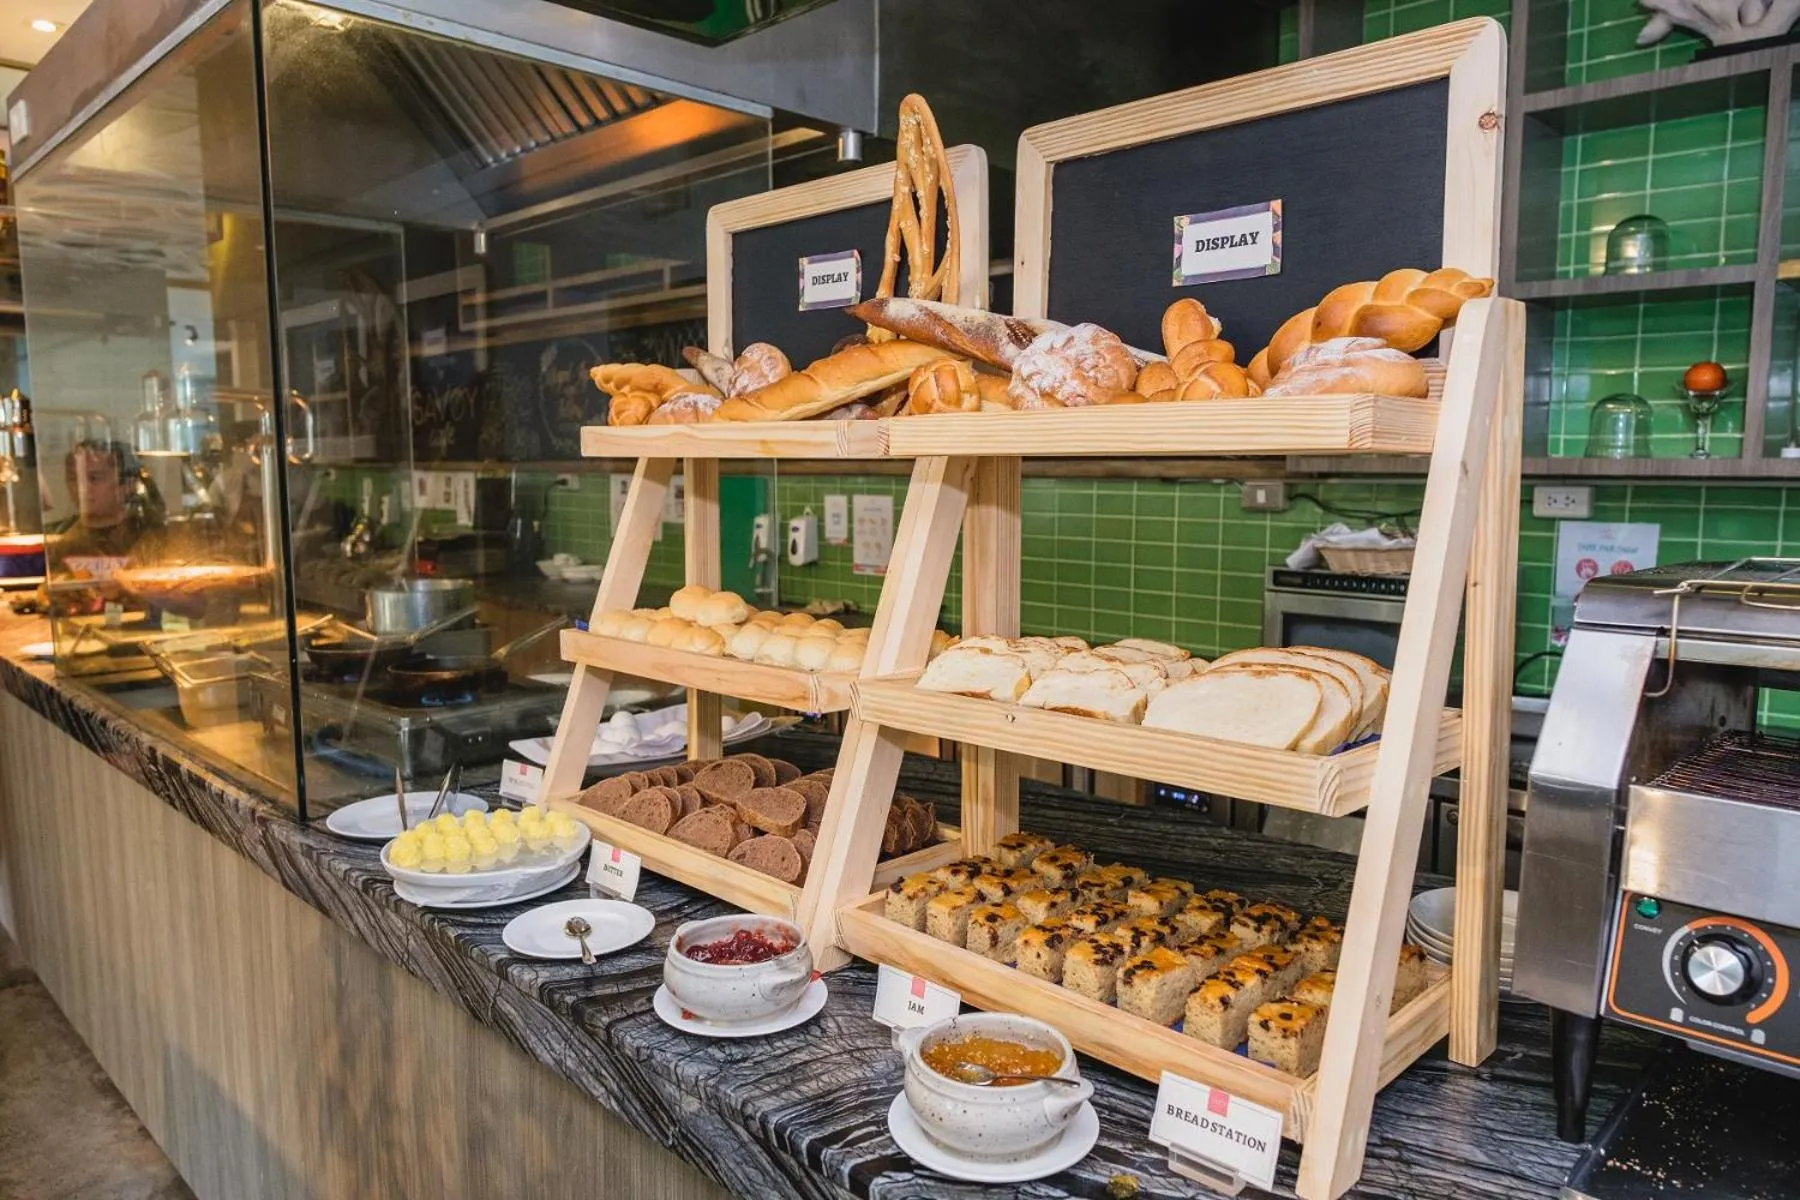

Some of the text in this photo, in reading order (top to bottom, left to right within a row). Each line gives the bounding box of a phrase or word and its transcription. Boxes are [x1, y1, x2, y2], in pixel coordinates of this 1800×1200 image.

[1194, 231, 1260, 253] DISPLAY
[811, 271, 849, 286] DISPLAY
[907, 1000, 925, 1016] JAM
[1166, 1103, 1268, 1154] BREAD STATION
